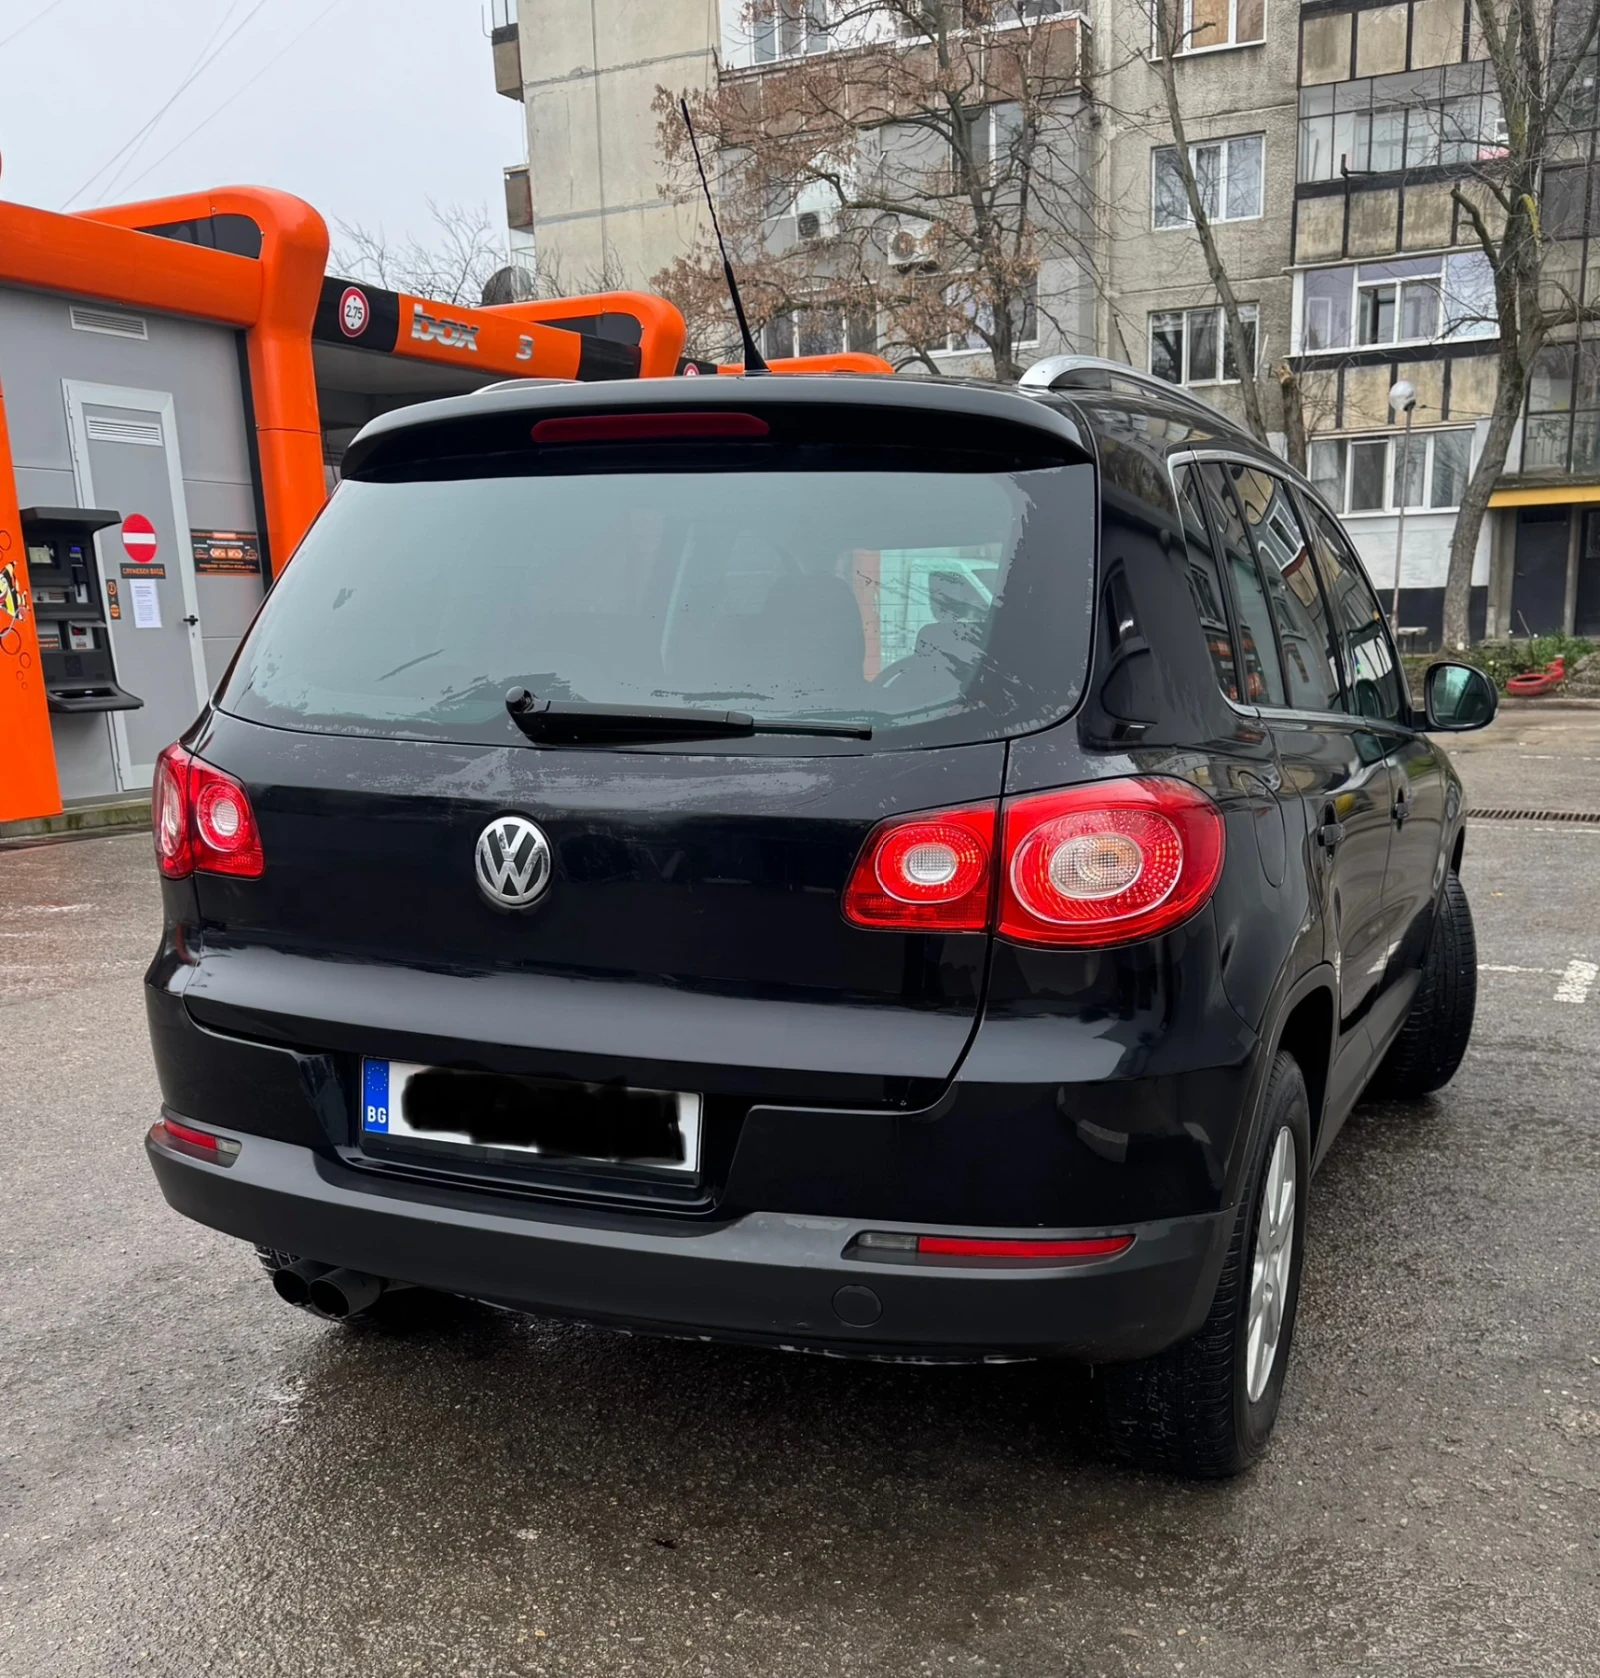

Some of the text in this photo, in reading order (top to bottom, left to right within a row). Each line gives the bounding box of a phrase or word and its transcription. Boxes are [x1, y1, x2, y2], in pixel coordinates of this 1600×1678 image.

[345, 304, 363, 320] 2.75
[411, 303, 534, 360] box 3
[475, 816, 550, 904] VW
[367, 1106, 387, 1124] BG
